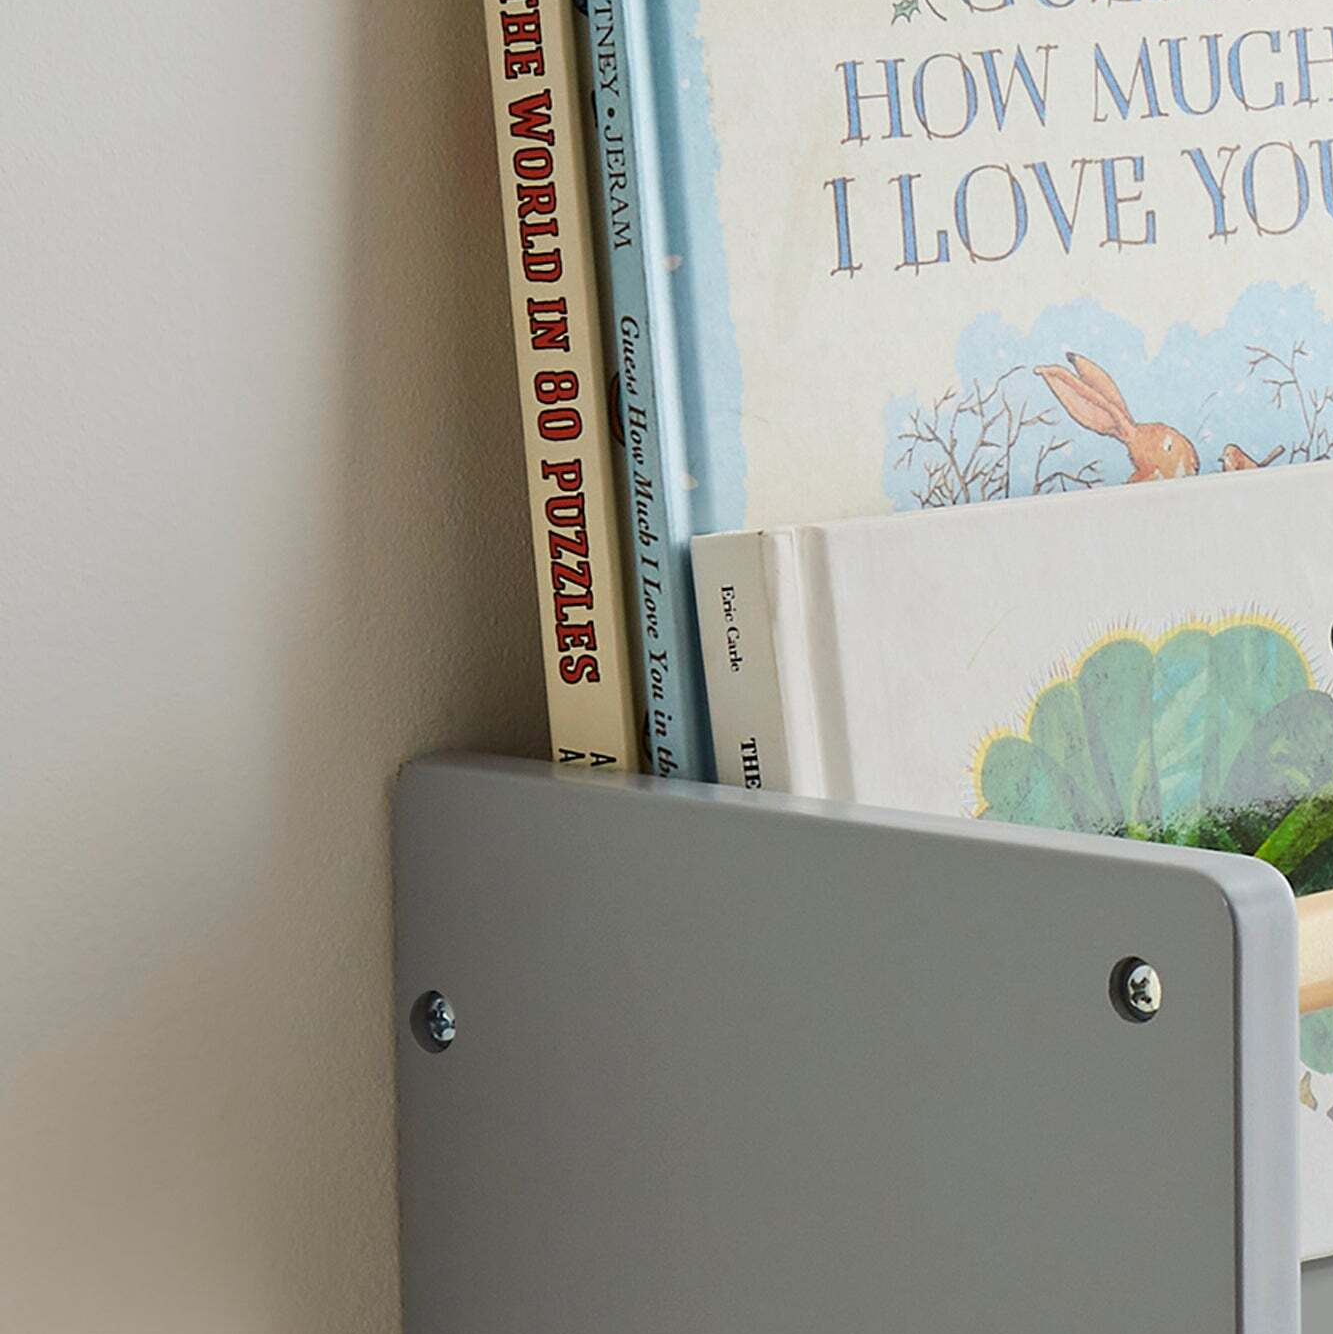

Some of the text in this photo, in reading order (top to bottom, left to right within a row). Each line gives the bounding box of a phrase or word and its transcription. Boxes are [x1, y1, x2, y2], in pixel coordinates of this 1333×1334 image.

[835, 44, 1058, 146] HOW
[507, 88, 563, 283] WORLD
[604, 124, 632, 251] JERAM
[823, 177, 863, 277] I
[889, 155, 1157, 276] LOVE
[526, 297, 569, 352] IN
[534, 369, 581, 443] 80
[541, 458, 601, 685] PUZZLES
[620, 315, 680, 779] Guess How Much I Love You in th
[720, 585, 741, 673] Eric Carle
[740, 737, 761, 789] THE
